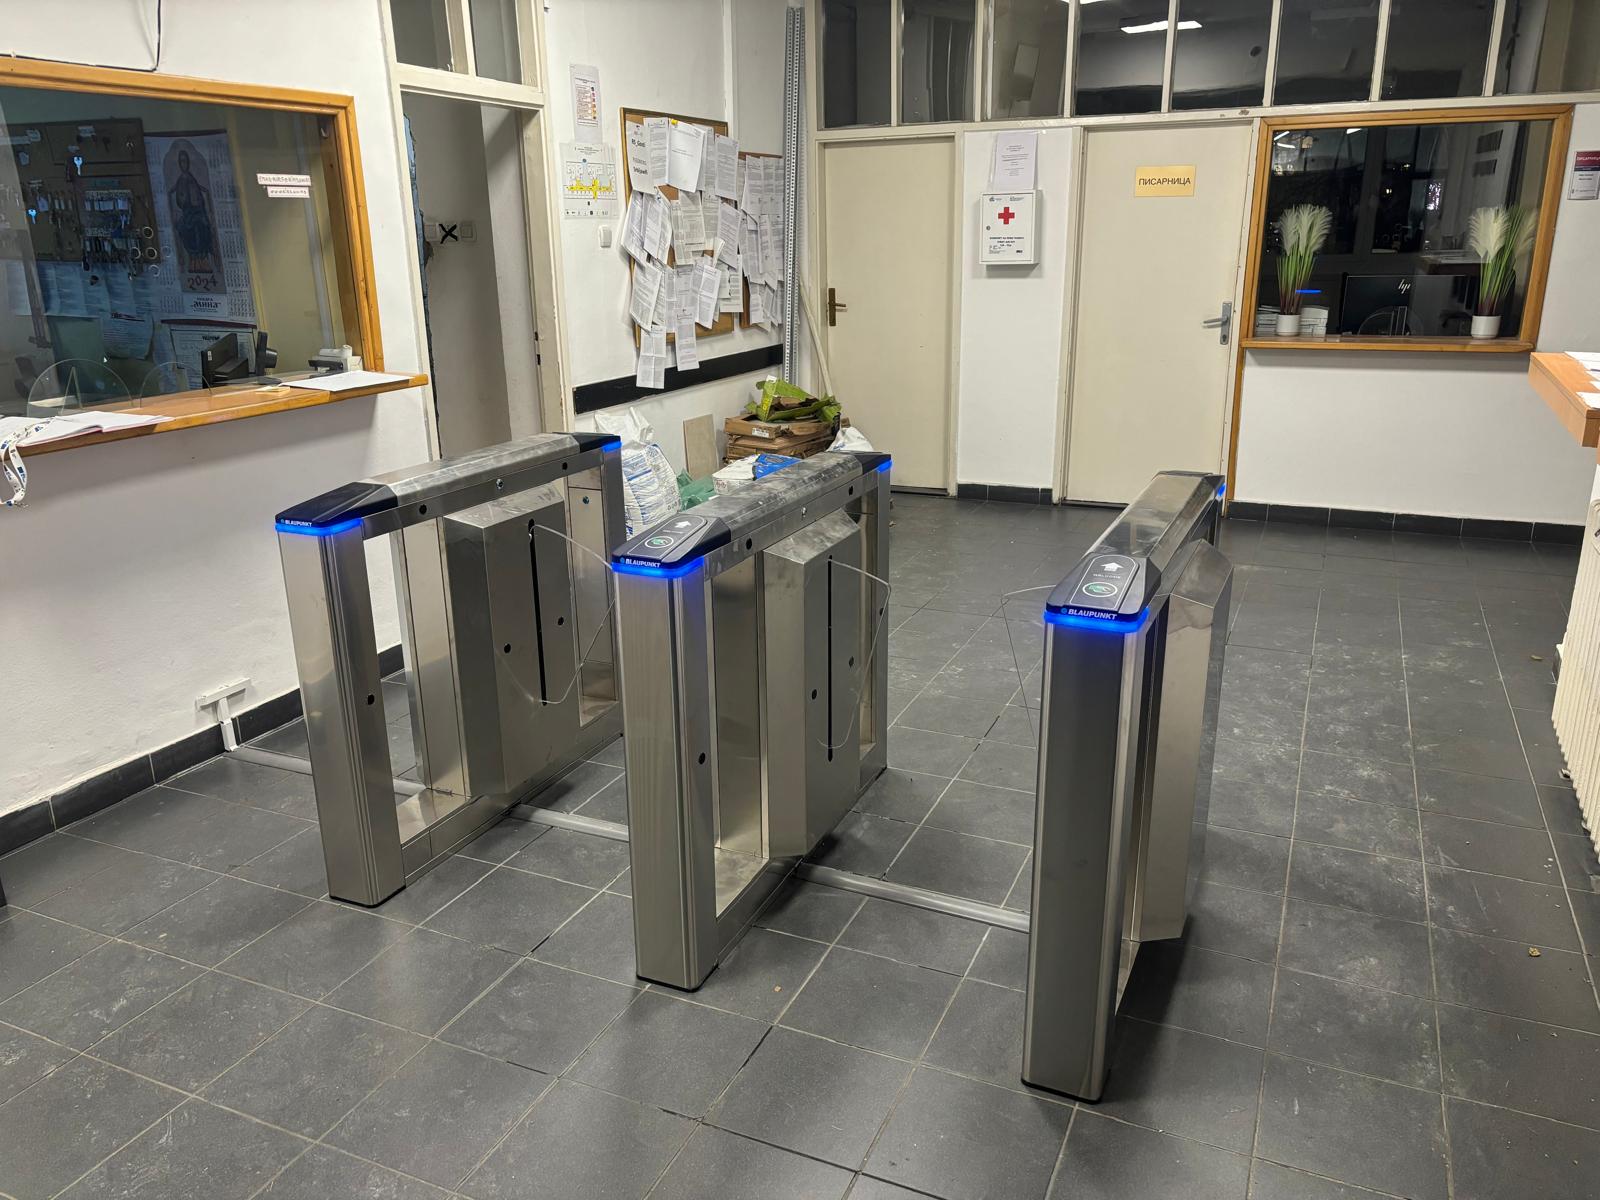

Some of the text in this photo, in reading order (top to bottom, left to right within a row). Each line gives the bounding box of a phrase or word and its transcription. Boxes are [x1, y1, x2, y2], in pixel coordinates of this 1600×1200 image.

[1138, 177, 1191, 186] ПИСАРНИЦА
[187, 274, 218, 291] 2024
[1398, 279, 1411, 294] hp
[625, 558, 661, 568] BLAUPUNKT
[1068, 609, 1118, 620] BLAUPUNKT
